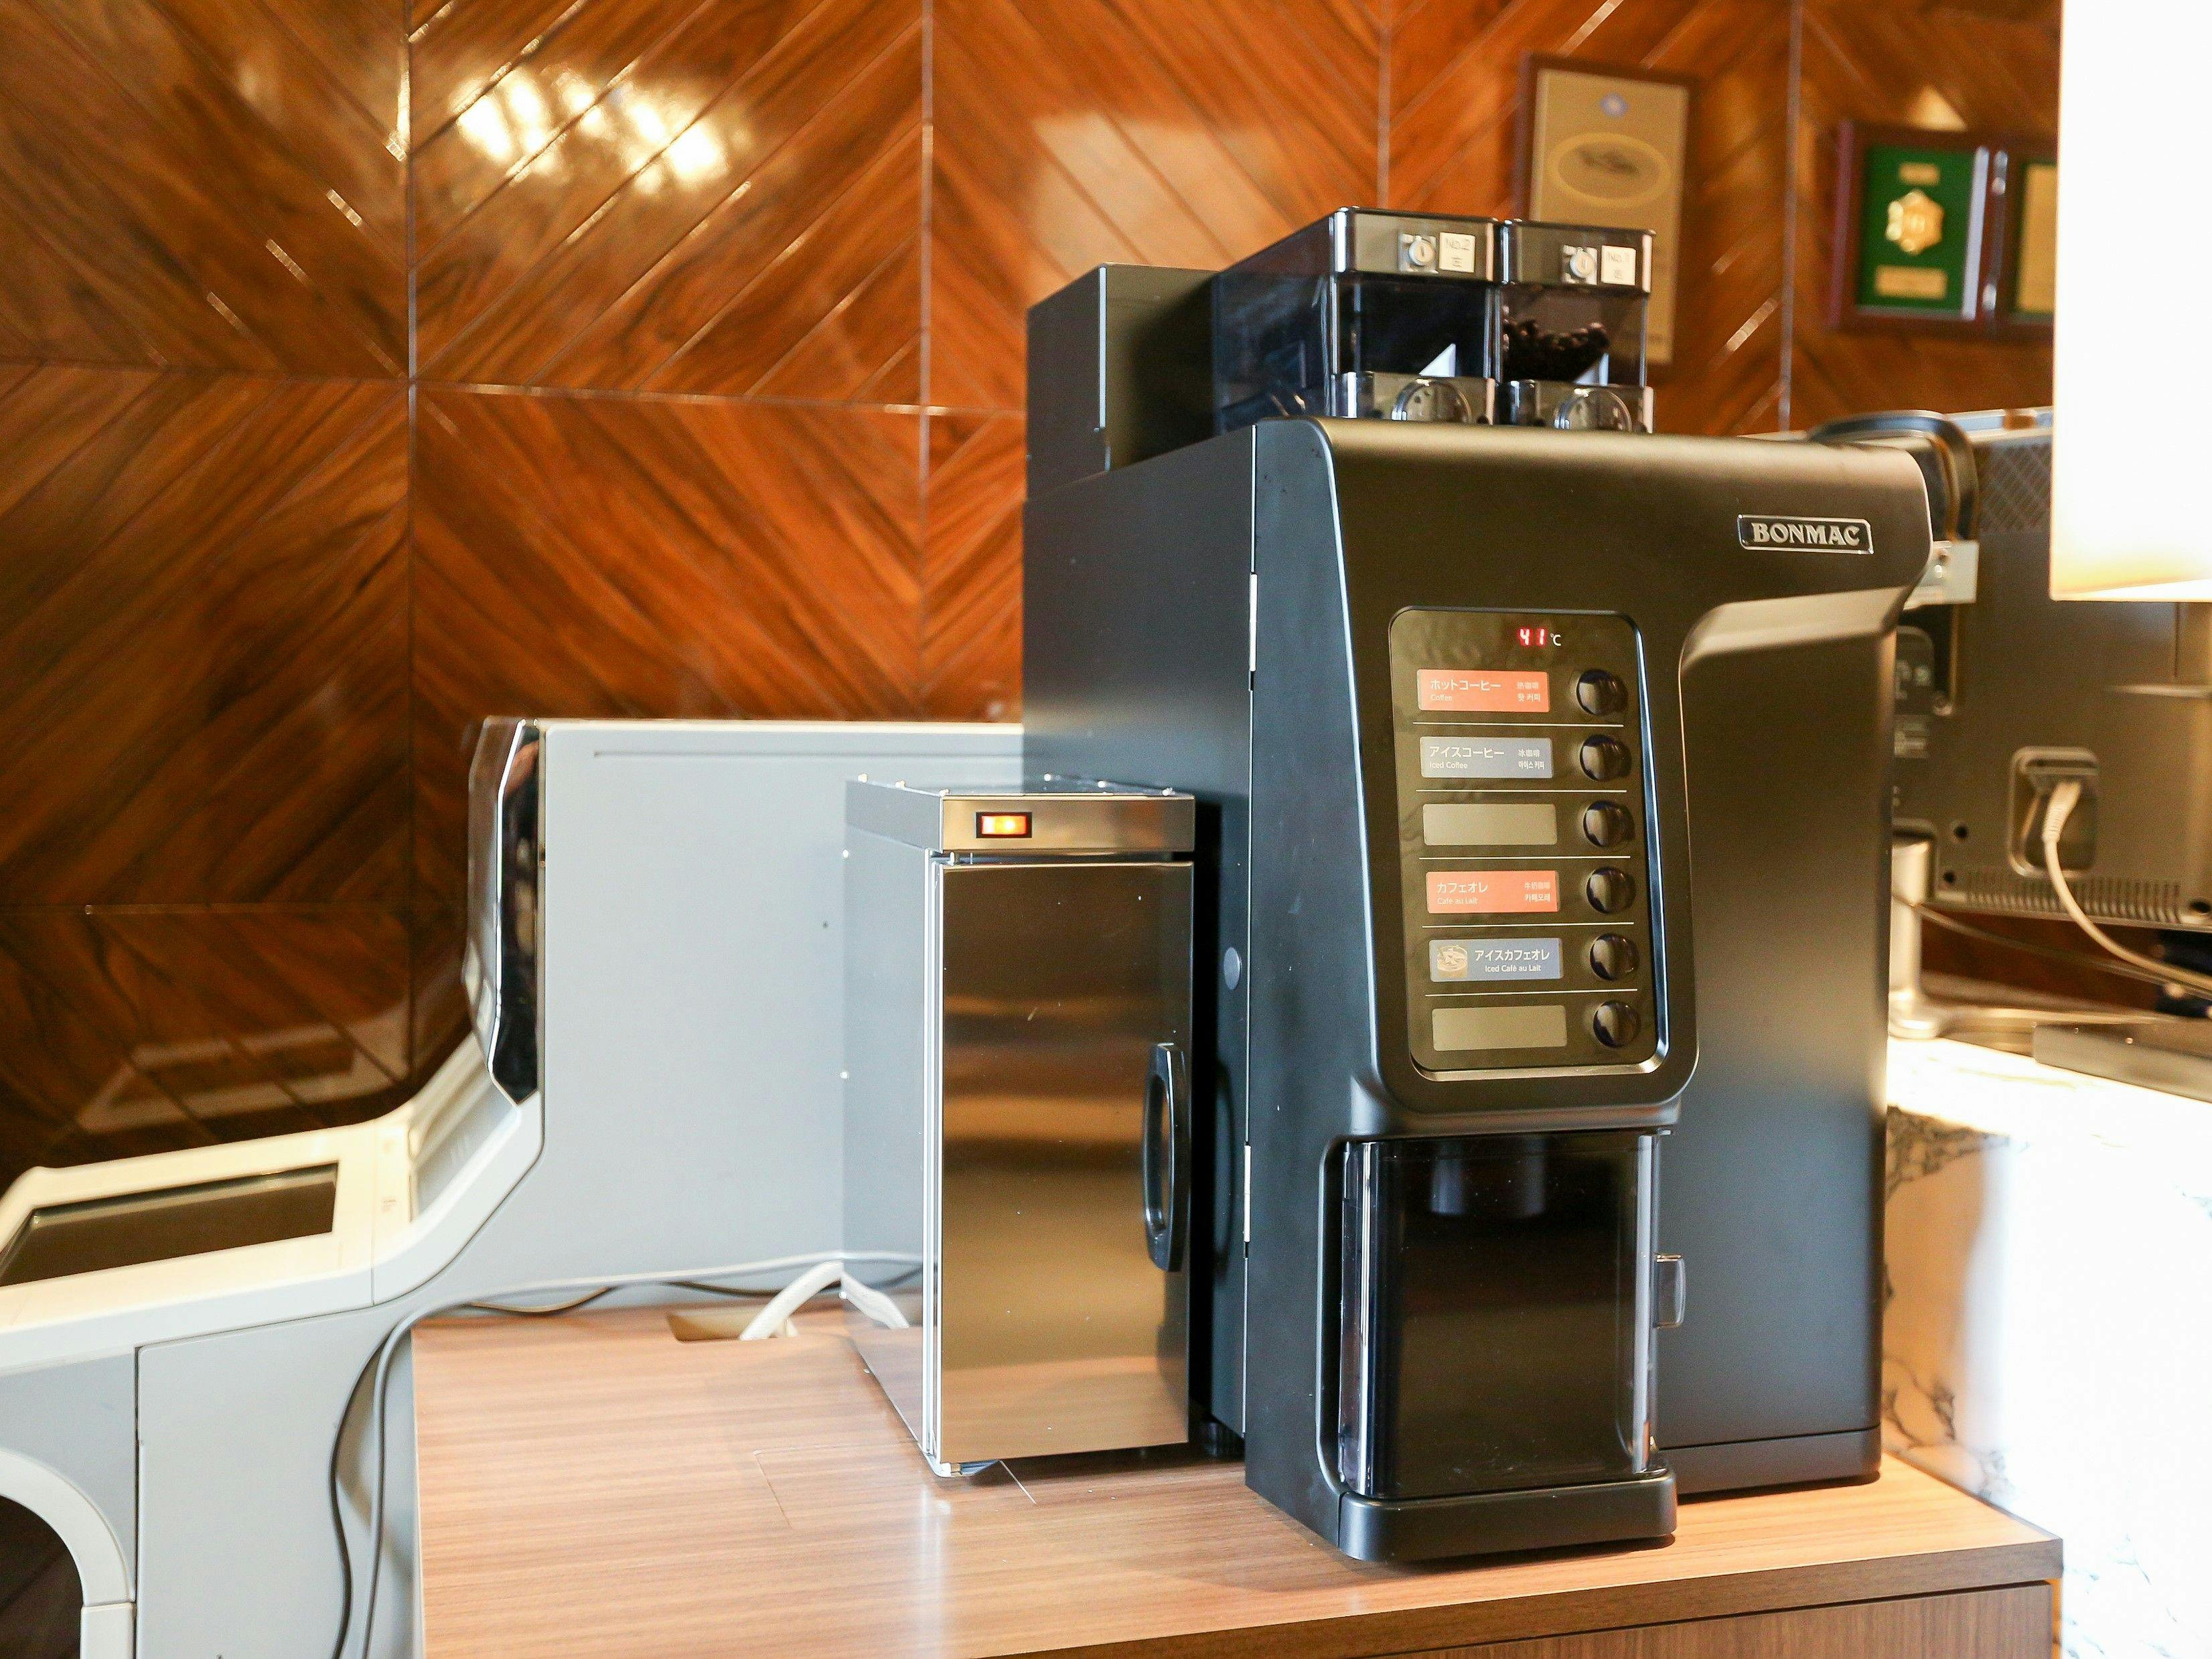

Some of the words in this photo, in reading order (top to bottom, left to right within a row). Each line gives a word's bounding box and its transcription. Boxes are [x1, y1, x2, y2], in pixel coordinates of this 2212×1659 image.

[1751, 522, 1860, 546] BONMAC
[1520, 628, 1545, 646] 41
[1430, 680, 1501, 691] ホットコーヒー
[1430, 694, 1453, 702] Coffee
[1429, 746, 1505, 758] アイスコーヒー
[1437, 881, 1488, 893] カフェオレ
[1465, 896, 1478, 904] Lait
[1475, 949, 1550, 961] アイスカフェオレ
[1485, 964, 1499, 972] Iced
